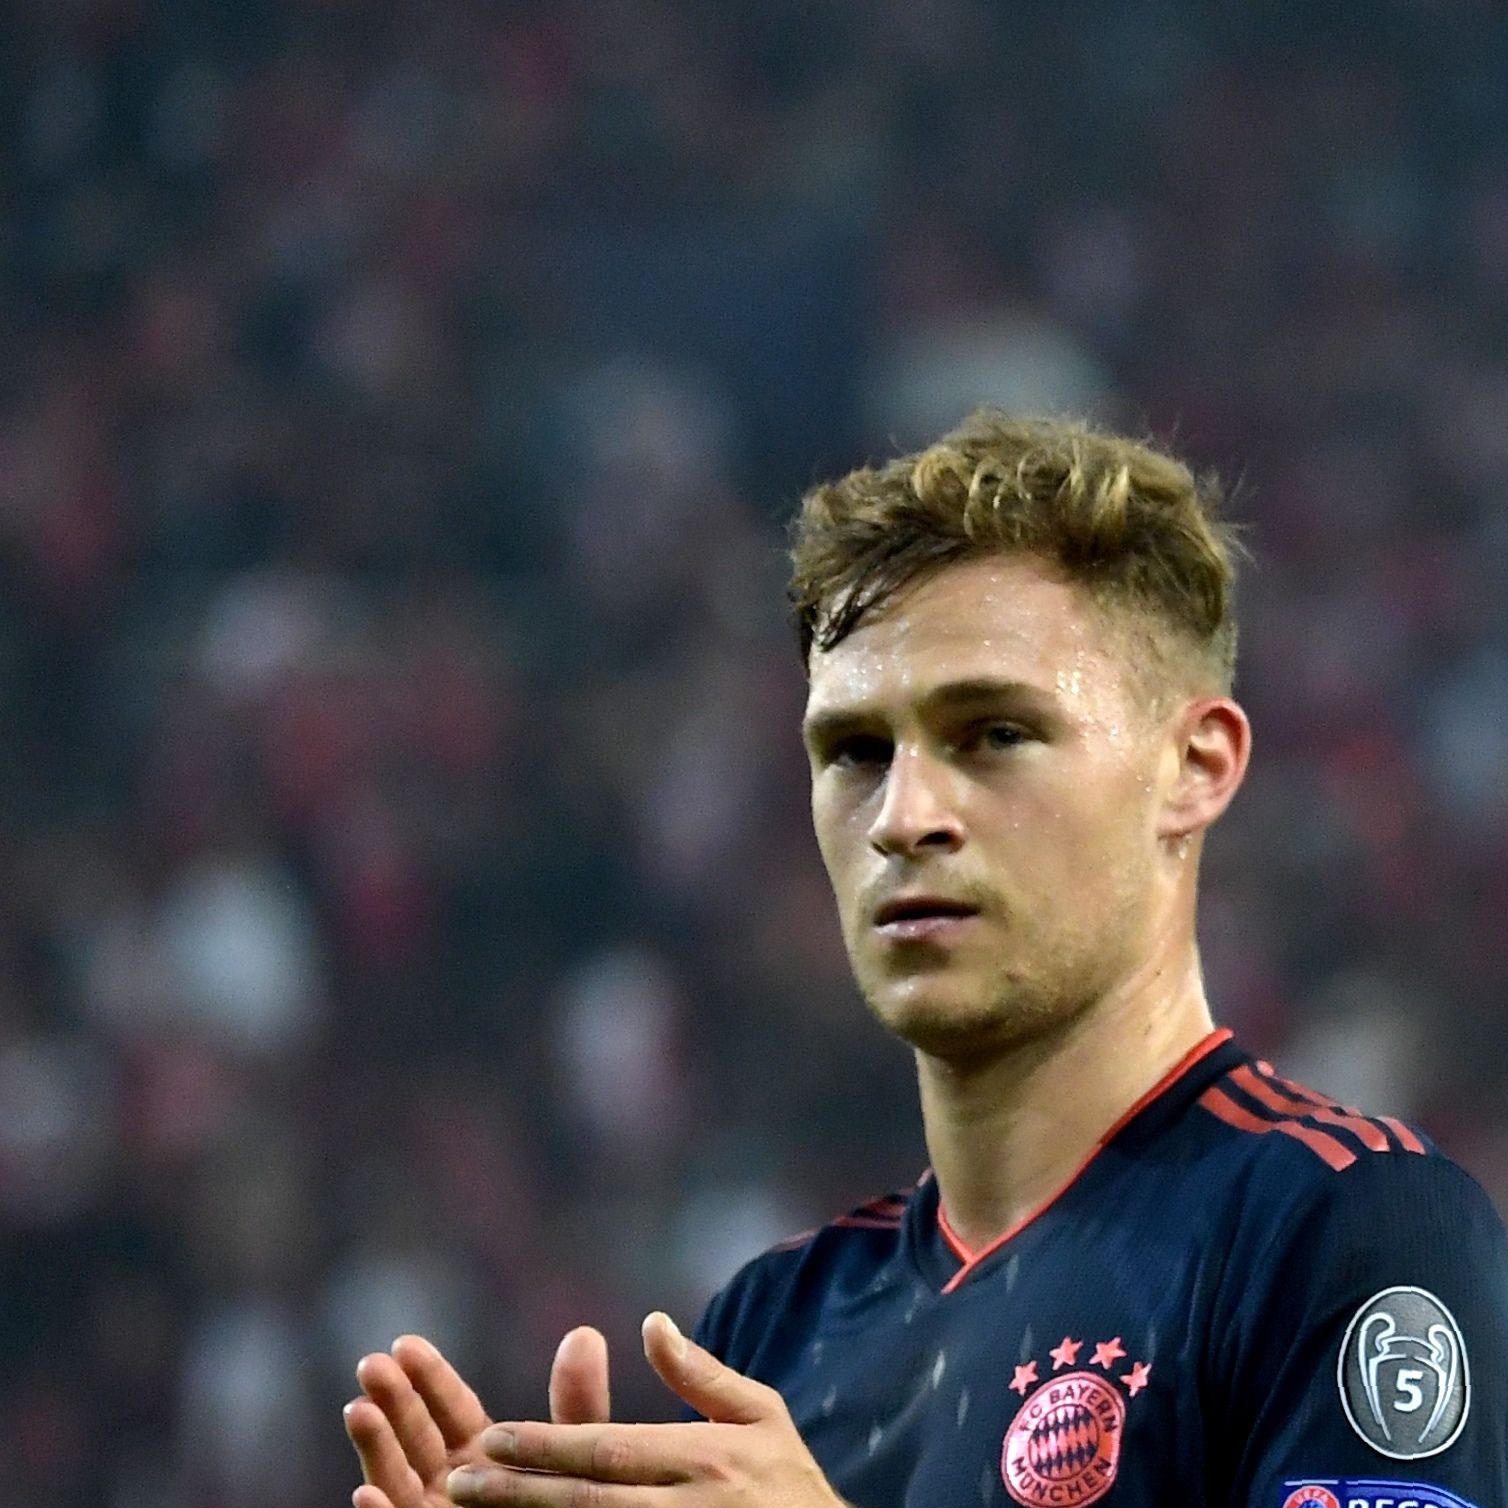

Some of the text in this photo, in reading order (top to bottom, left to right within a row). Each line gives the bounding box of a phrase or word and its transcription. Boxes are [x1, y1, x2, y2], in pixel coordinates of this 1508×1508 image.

[1019, 1384, 1118, 1433] FC BAYERN
[1393, 1368, 1424, 1412] 5
